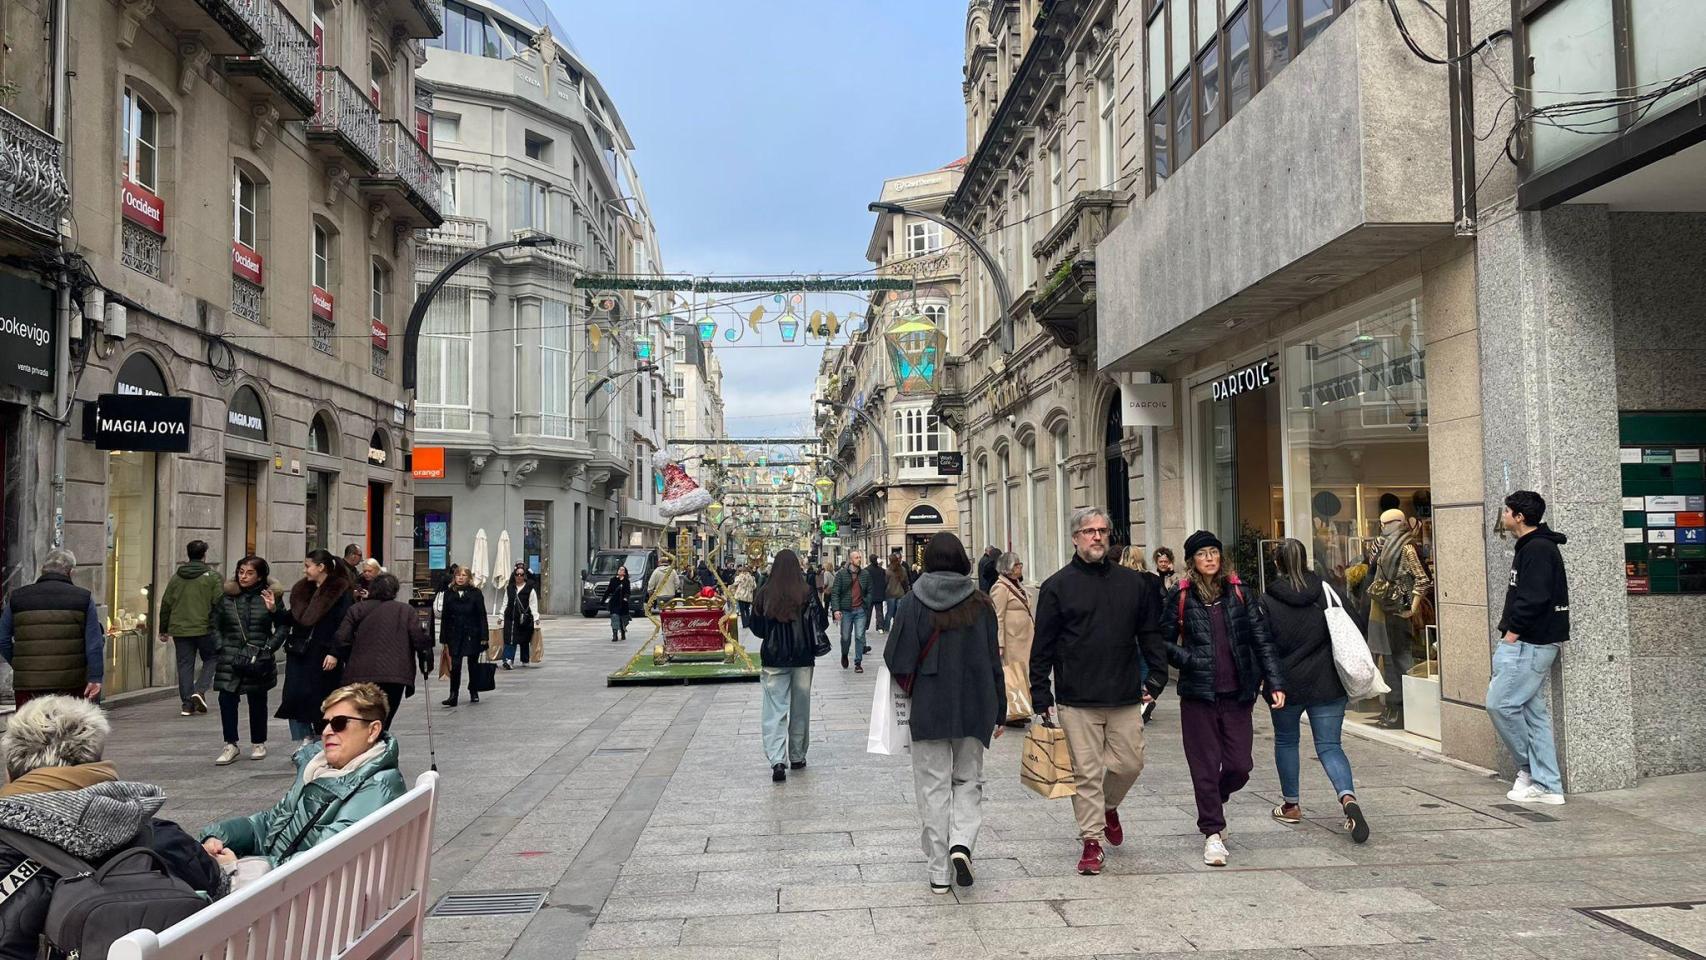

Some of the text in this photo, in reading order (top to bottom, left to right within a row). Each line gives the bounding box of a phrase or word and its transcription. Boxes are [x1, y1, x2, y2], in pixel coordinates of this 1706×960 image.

[126, 192, 160, 221] Occident
[235, 252, 260, 274] Occident
[313, 294, 332, 312] Occident
[1212, 362, 1269, 402] PARFOIS
[101, 419, 185, 434] MAGIA JOYA
[228, 411, 262, 431] MAGIA JOYA
[413, 469, 440, 478] orange
